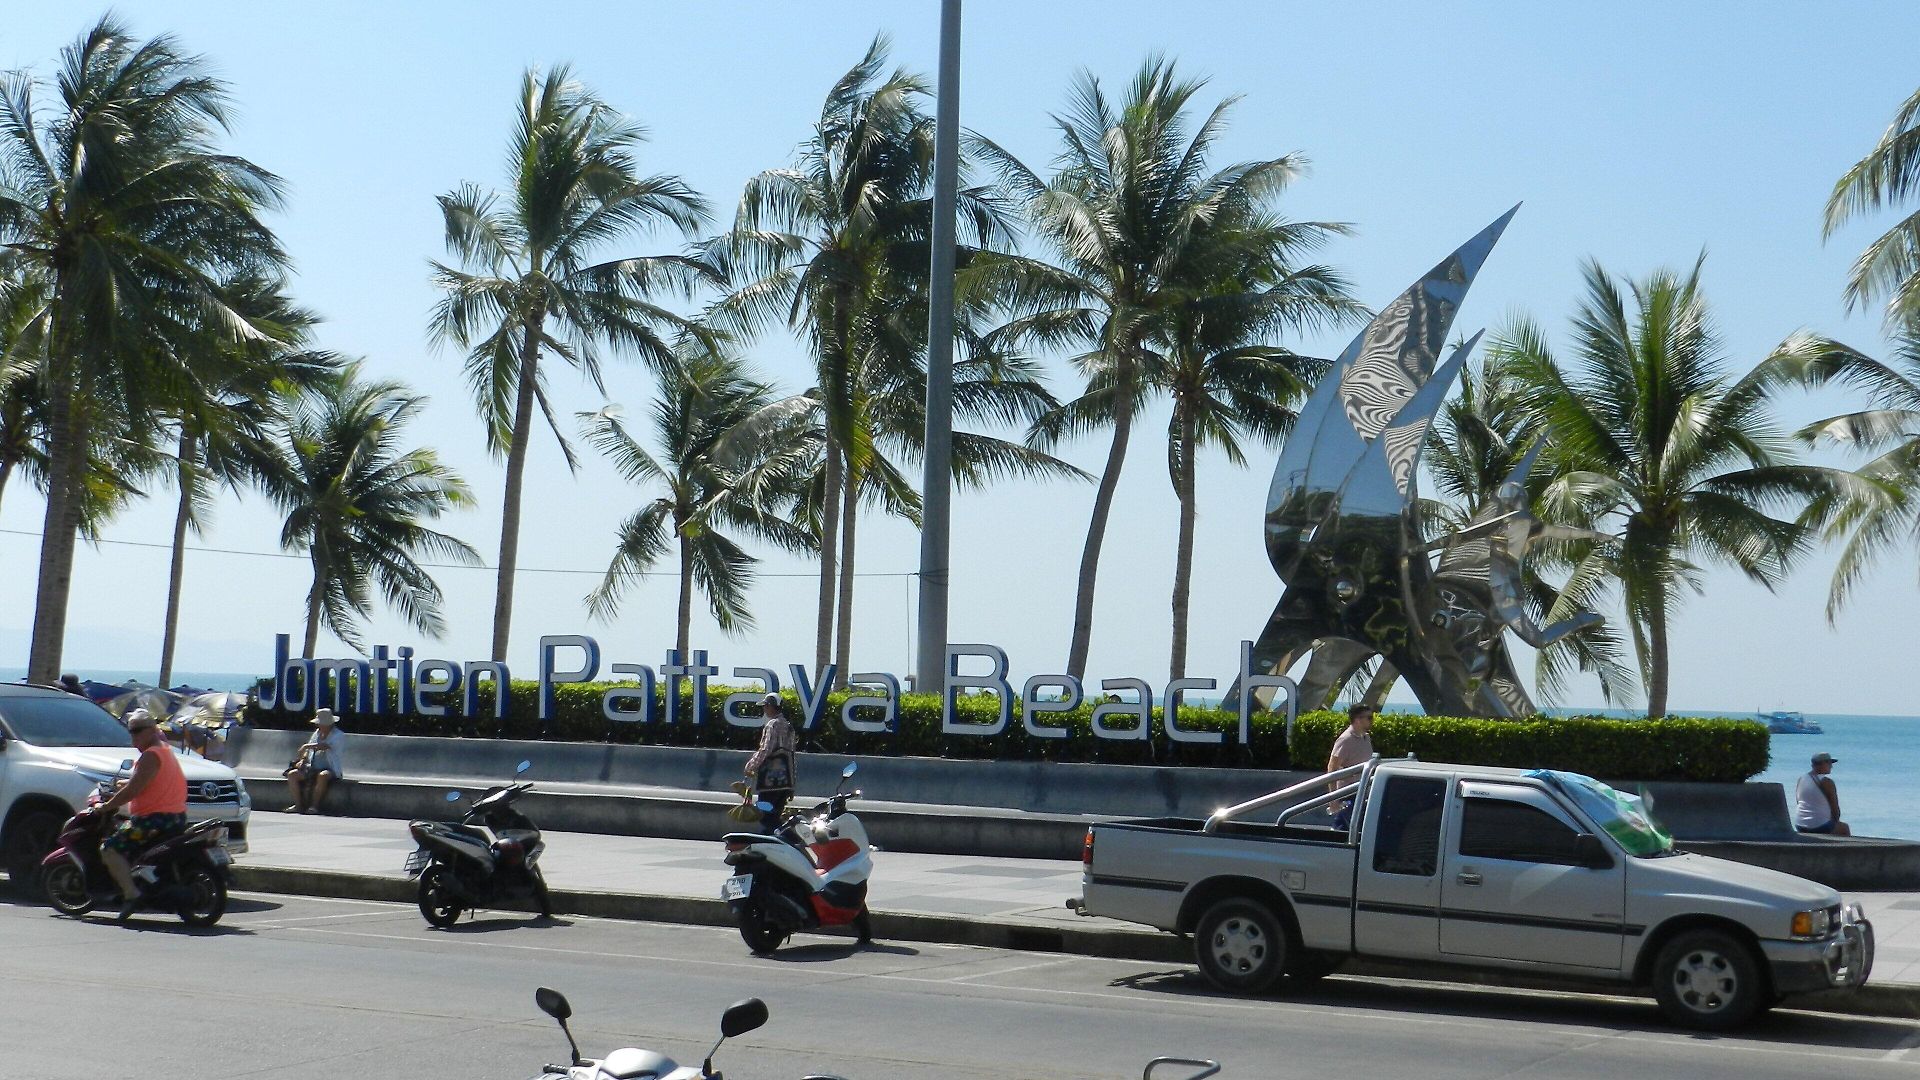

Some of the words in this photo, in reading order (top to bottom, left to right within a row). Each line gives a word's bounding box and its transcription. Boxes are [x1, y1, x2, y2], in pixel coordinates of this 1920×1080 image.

[258, 633, 510, 718] Jomtien
[538, 634, 900, 733] Pattaya
[942, 640, 1300, 745] Beach
